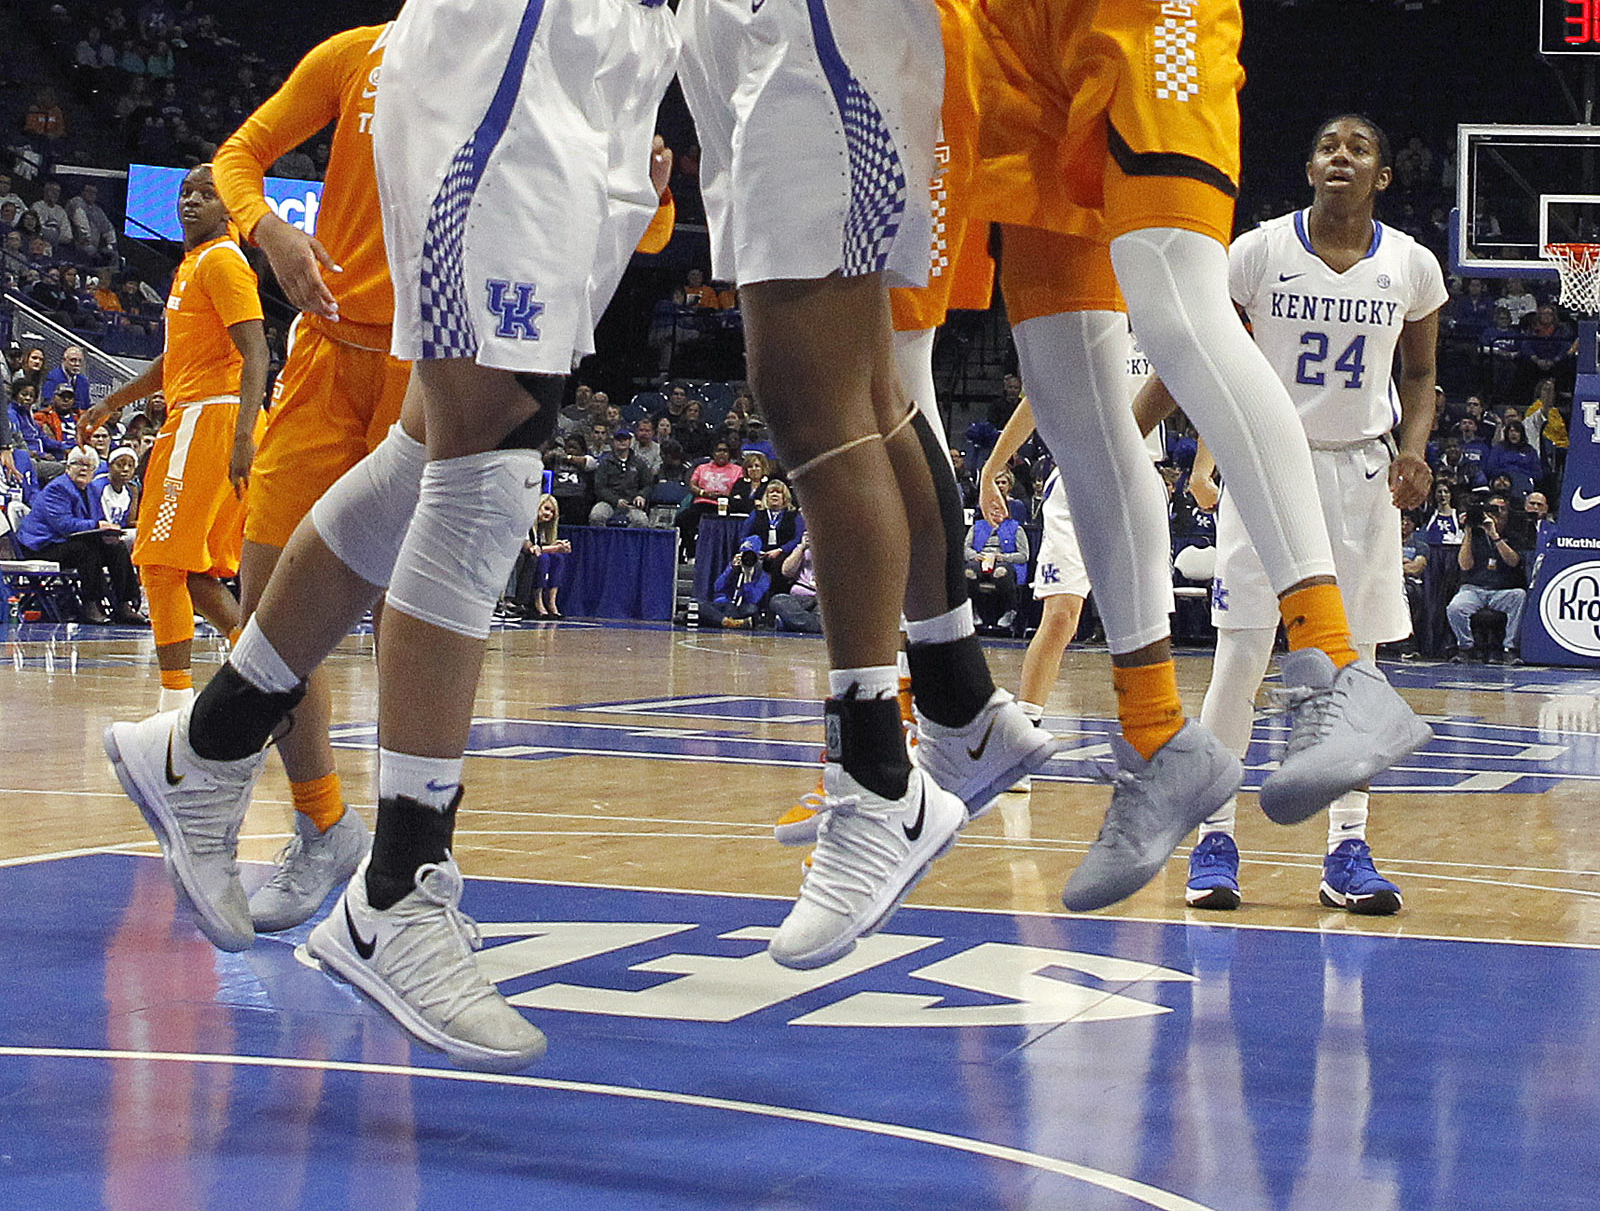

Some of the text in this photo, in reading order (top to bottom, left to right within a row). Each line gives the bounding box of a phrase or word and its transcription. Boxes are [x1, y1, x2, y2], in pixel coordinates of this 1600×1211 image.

[486, 278, 546, 341] UK
[1271, 292, 1398, 326] KENTUCKY
[1296, 331, 1366, 389] 24
[557, 471, 579, 485] 34
[1041, 563, 1061, 585] UK
